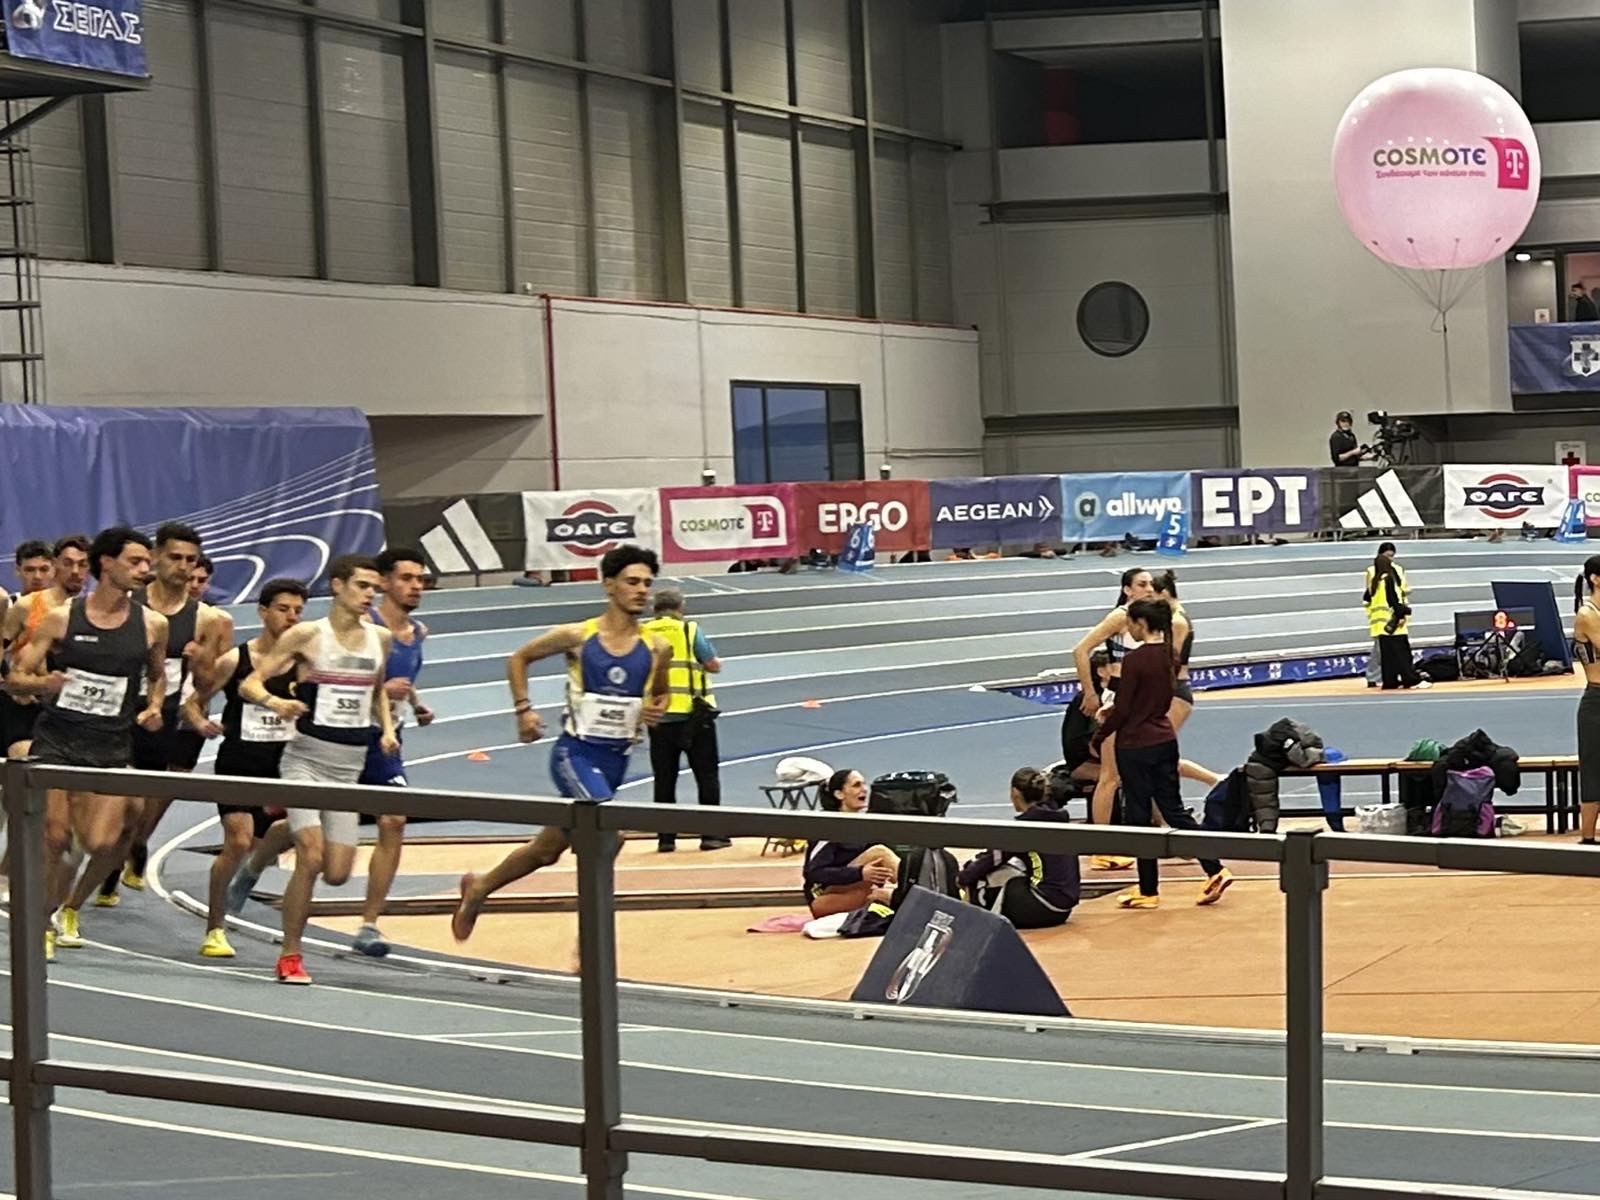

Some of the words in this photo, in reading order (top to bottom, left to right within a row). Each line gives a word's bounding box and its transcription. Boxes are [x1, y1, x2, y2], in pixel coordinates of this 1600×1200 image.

[52, 0, 142, 44] ΣΕΓΑΣ
[1373, 147, 1487, 167] COSMOTE
[818, 501, 909, 533] ERGO
[937, 502, 1033, 522] AEGEAN
[680, 517, 744, 533] COSMOTE
[1167, 514, 1181, 536] 5
